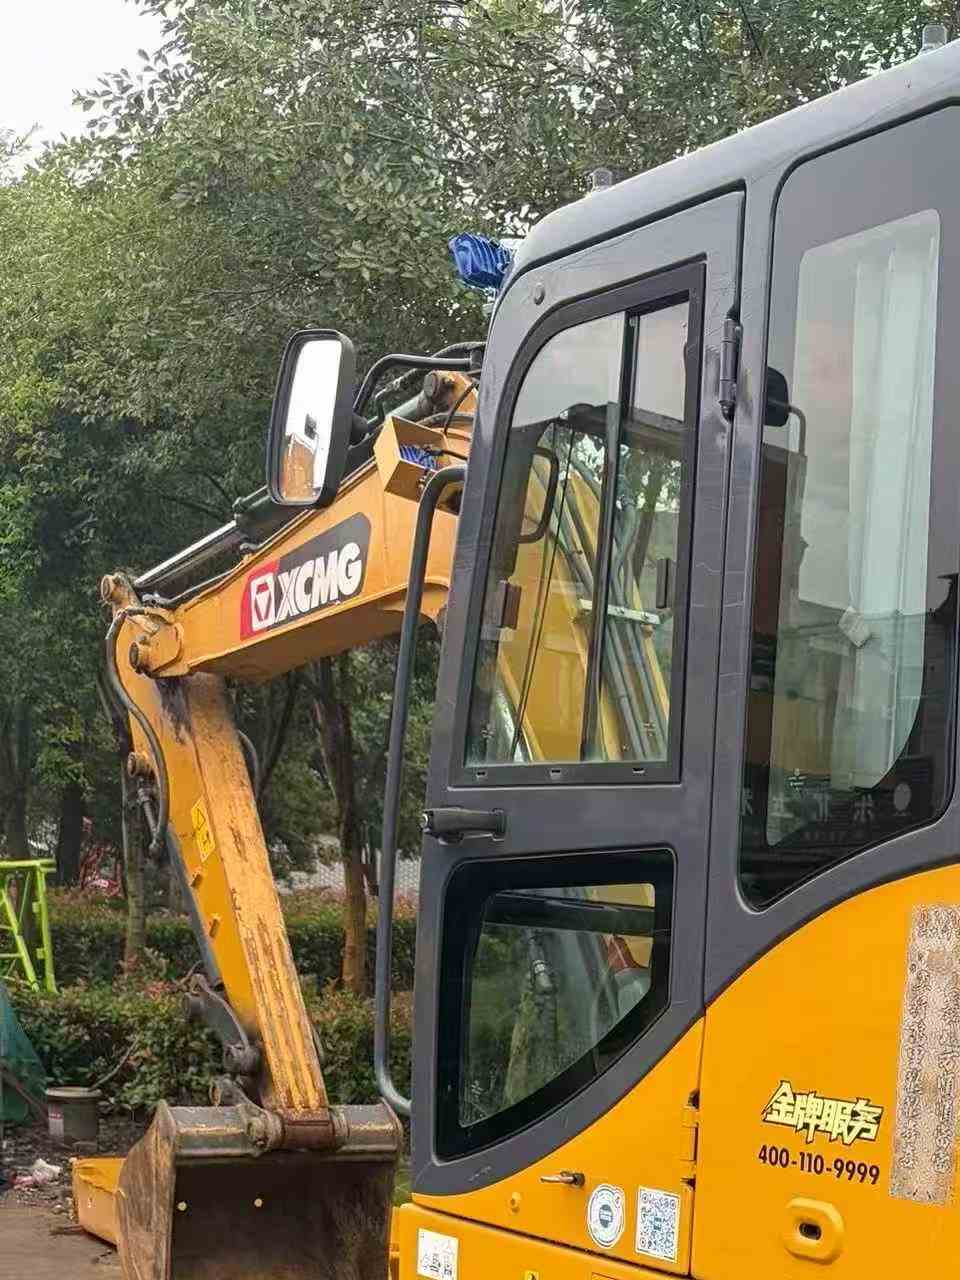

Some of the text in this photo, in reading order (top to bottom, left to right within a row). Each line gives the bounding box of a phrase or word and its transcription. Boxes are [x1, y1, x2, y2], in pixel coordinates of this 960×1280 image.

[275, 542, 362, 623] XCMG
[761, 1080, 884, 1146] 金牌服务
[758, 1145, 880, 1185] 400-110-9999
